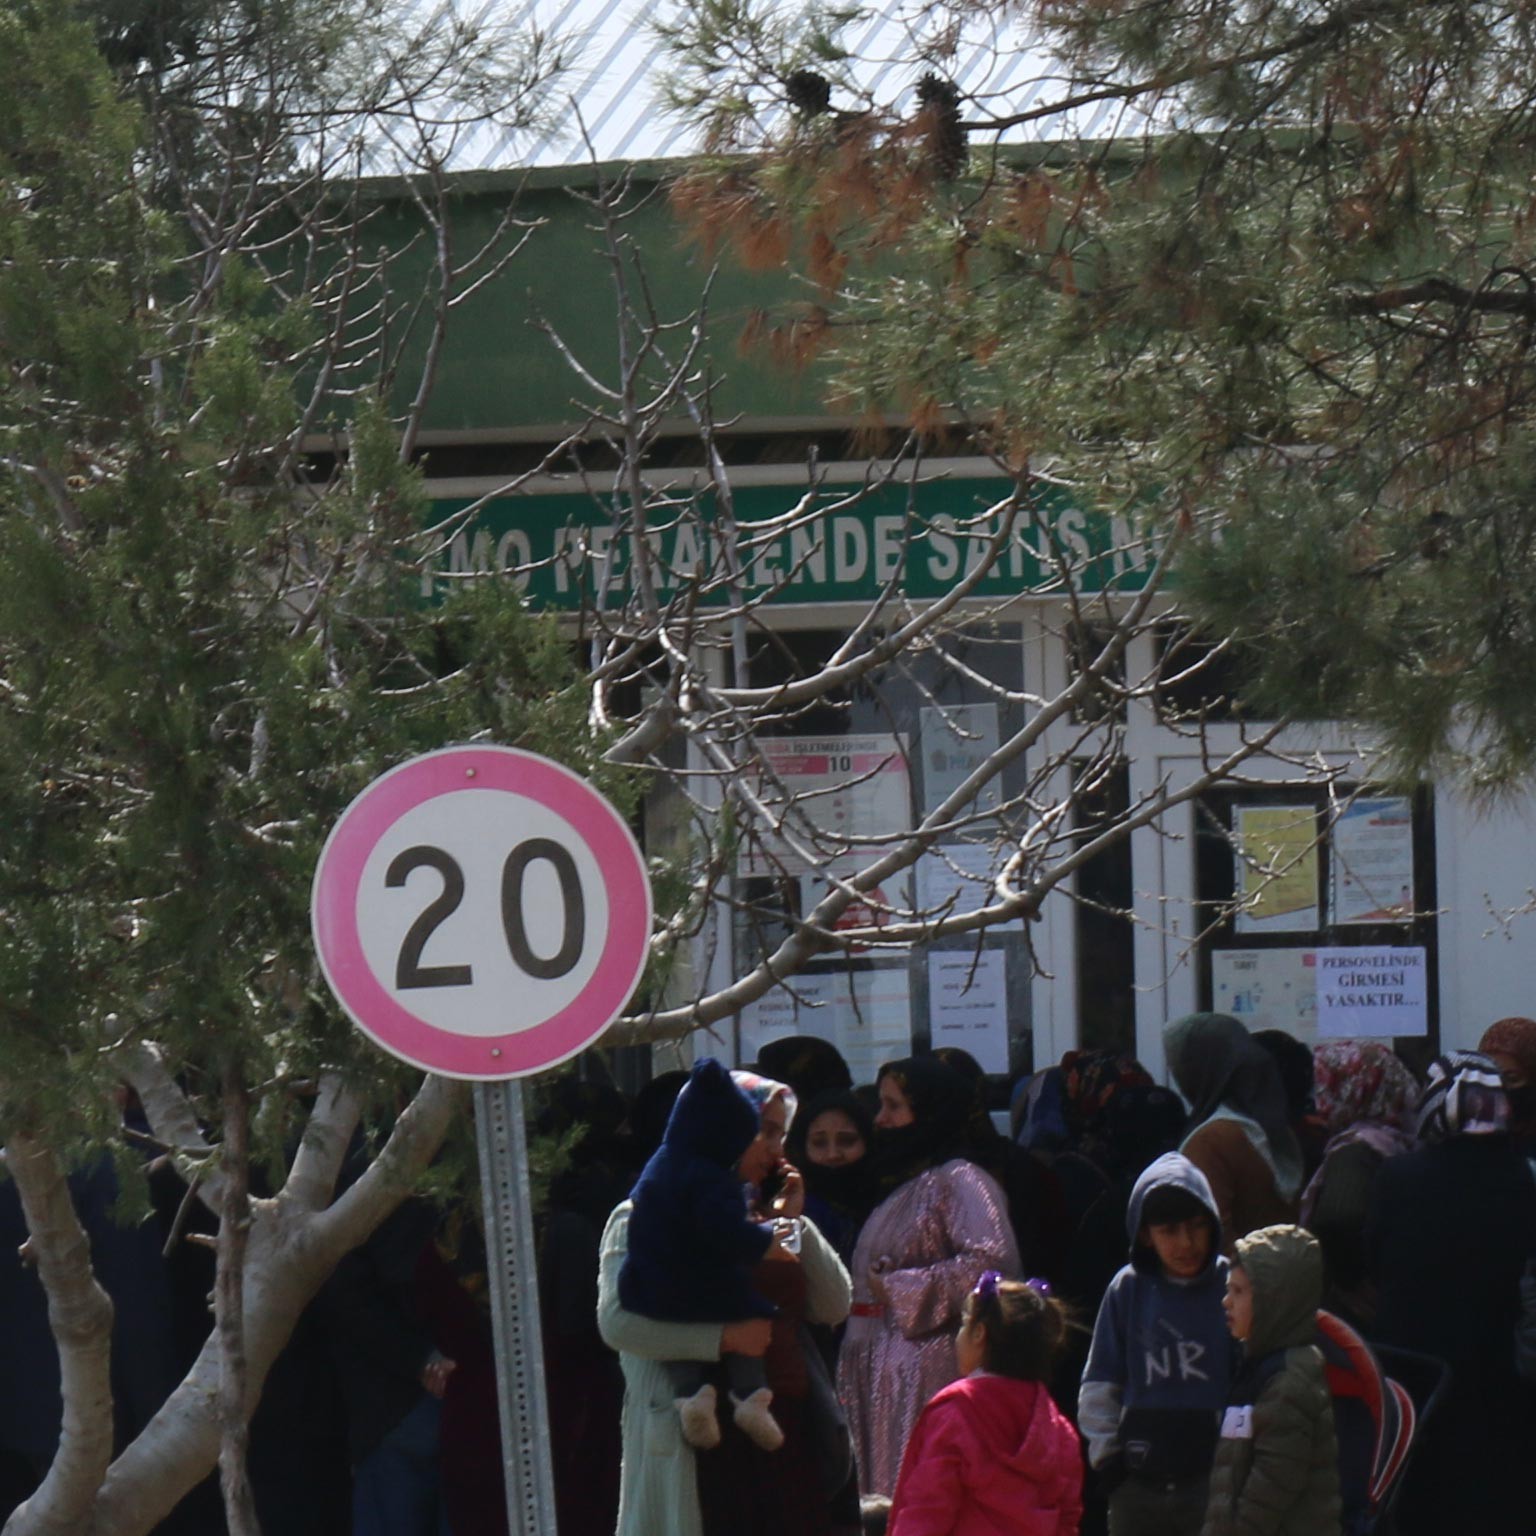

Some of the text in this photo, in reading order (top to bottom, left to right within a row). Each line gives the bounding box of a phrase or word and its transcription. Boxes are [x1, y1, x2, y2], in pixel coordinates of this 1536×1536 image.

[554, 514, 906, 594] PERAKENDE
[927, 507, 1091, 592] SATIŞ
[829, 756, 851, 772] 10
[384, 837, 586, 990] 20
[1338, 970, 1404, 987] GİRMESİ
[1145, 1340, 1209, 1386] NR
